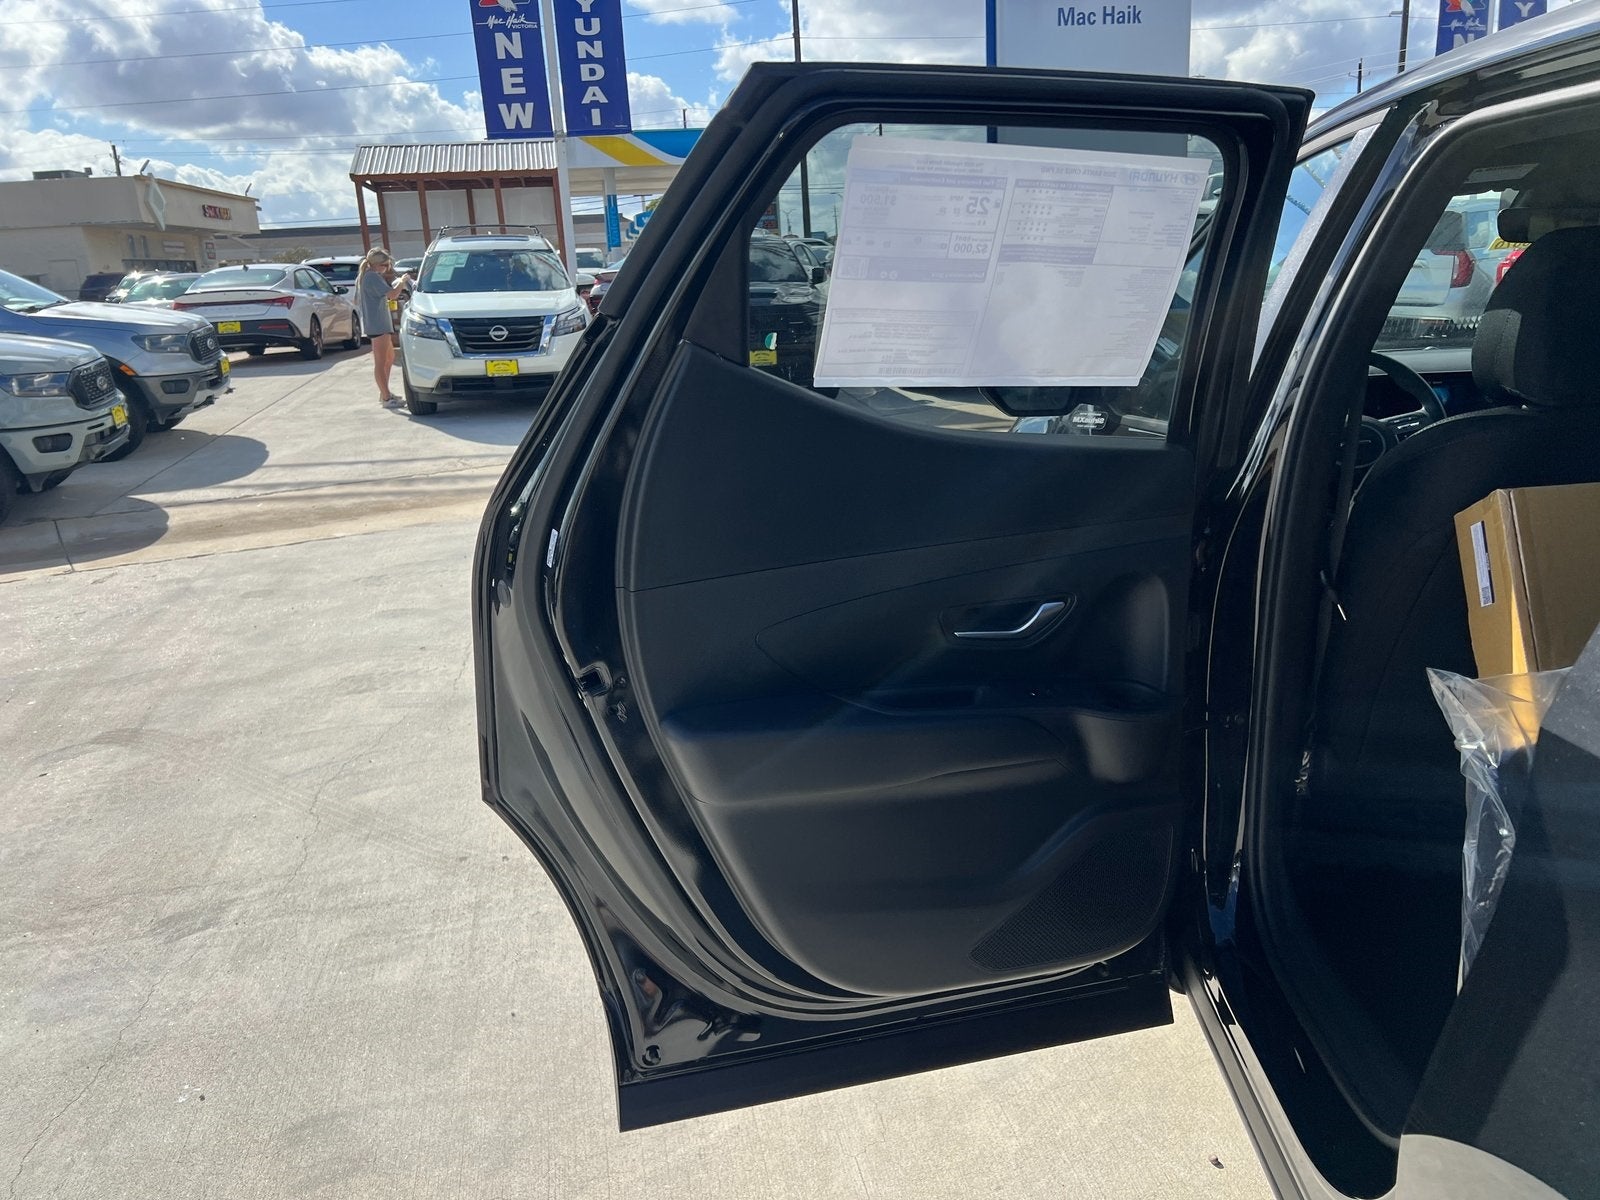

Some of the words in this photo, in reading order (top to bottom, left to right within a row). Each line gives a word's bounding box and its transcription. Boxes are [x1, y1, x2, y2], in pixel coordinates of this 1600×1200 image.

[485, 14, 506, 29] Mac
[505, 13, 530, 29] Haik
[1057, 7, 1097, 26] Mac
[1102, 5, 1142, 24] Haik
[494, 32, 534, 130] NEW
